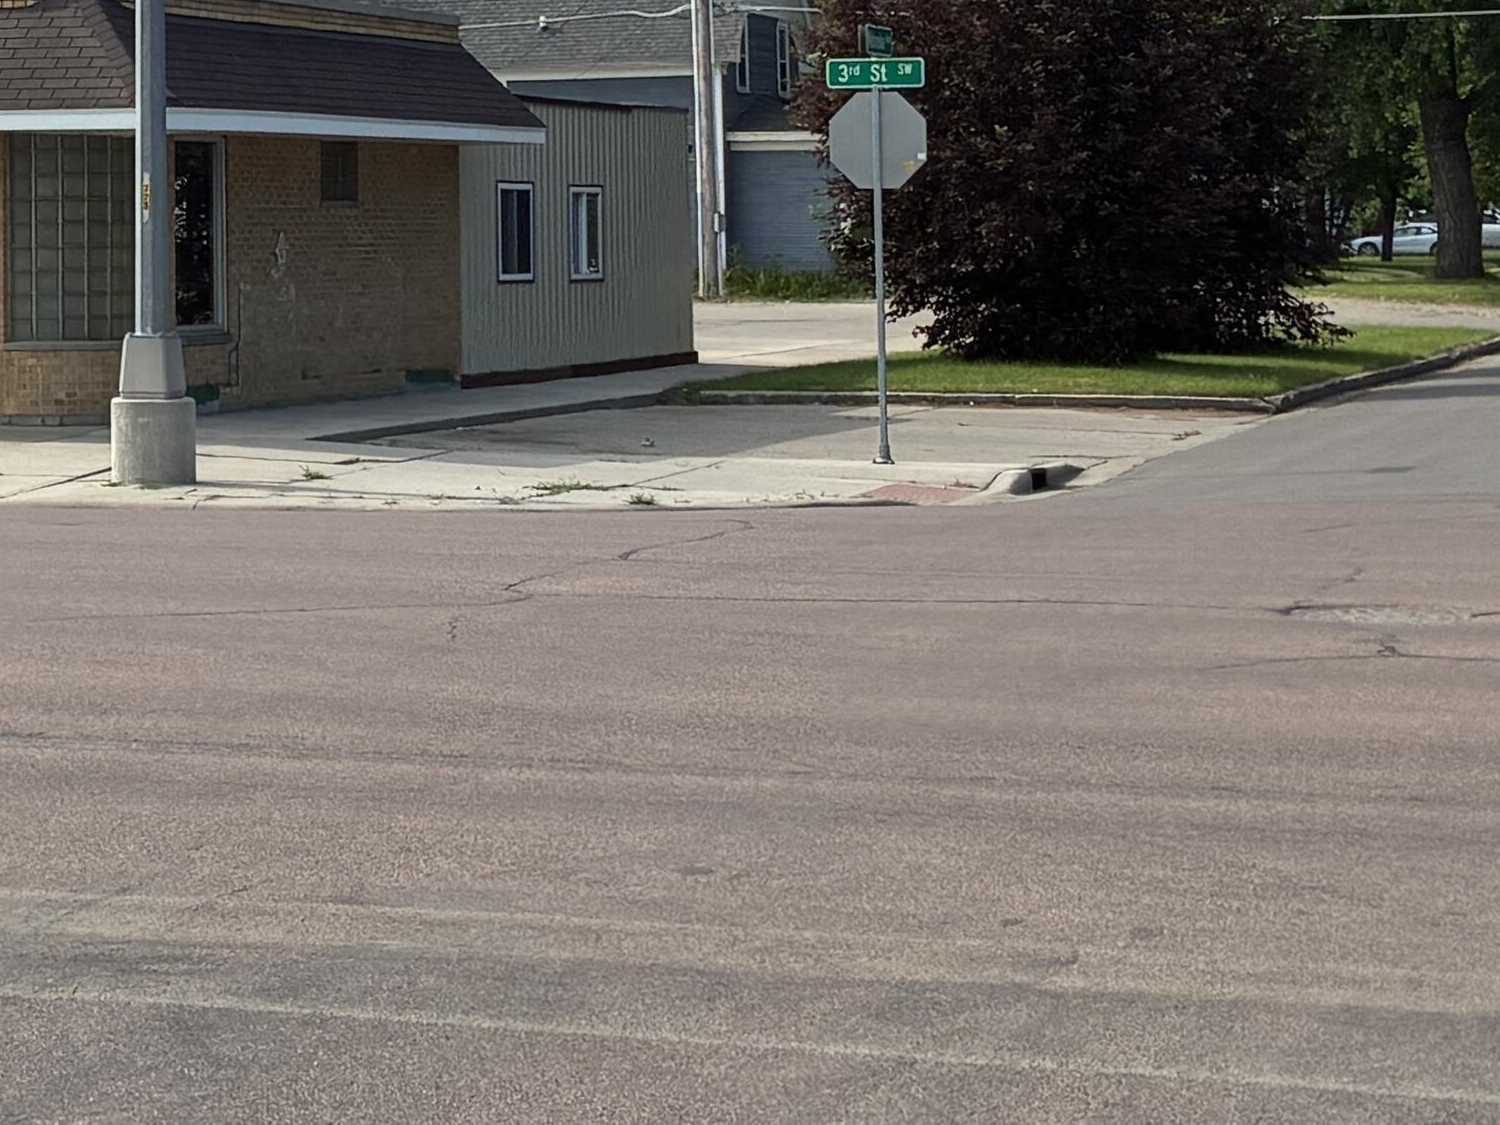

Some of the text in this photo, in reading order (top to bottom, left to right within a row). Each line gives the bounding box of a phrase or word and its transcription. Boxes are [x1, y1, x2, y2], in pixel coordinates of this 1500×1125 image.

[838, 63, 913, 83] 3rd St SW
